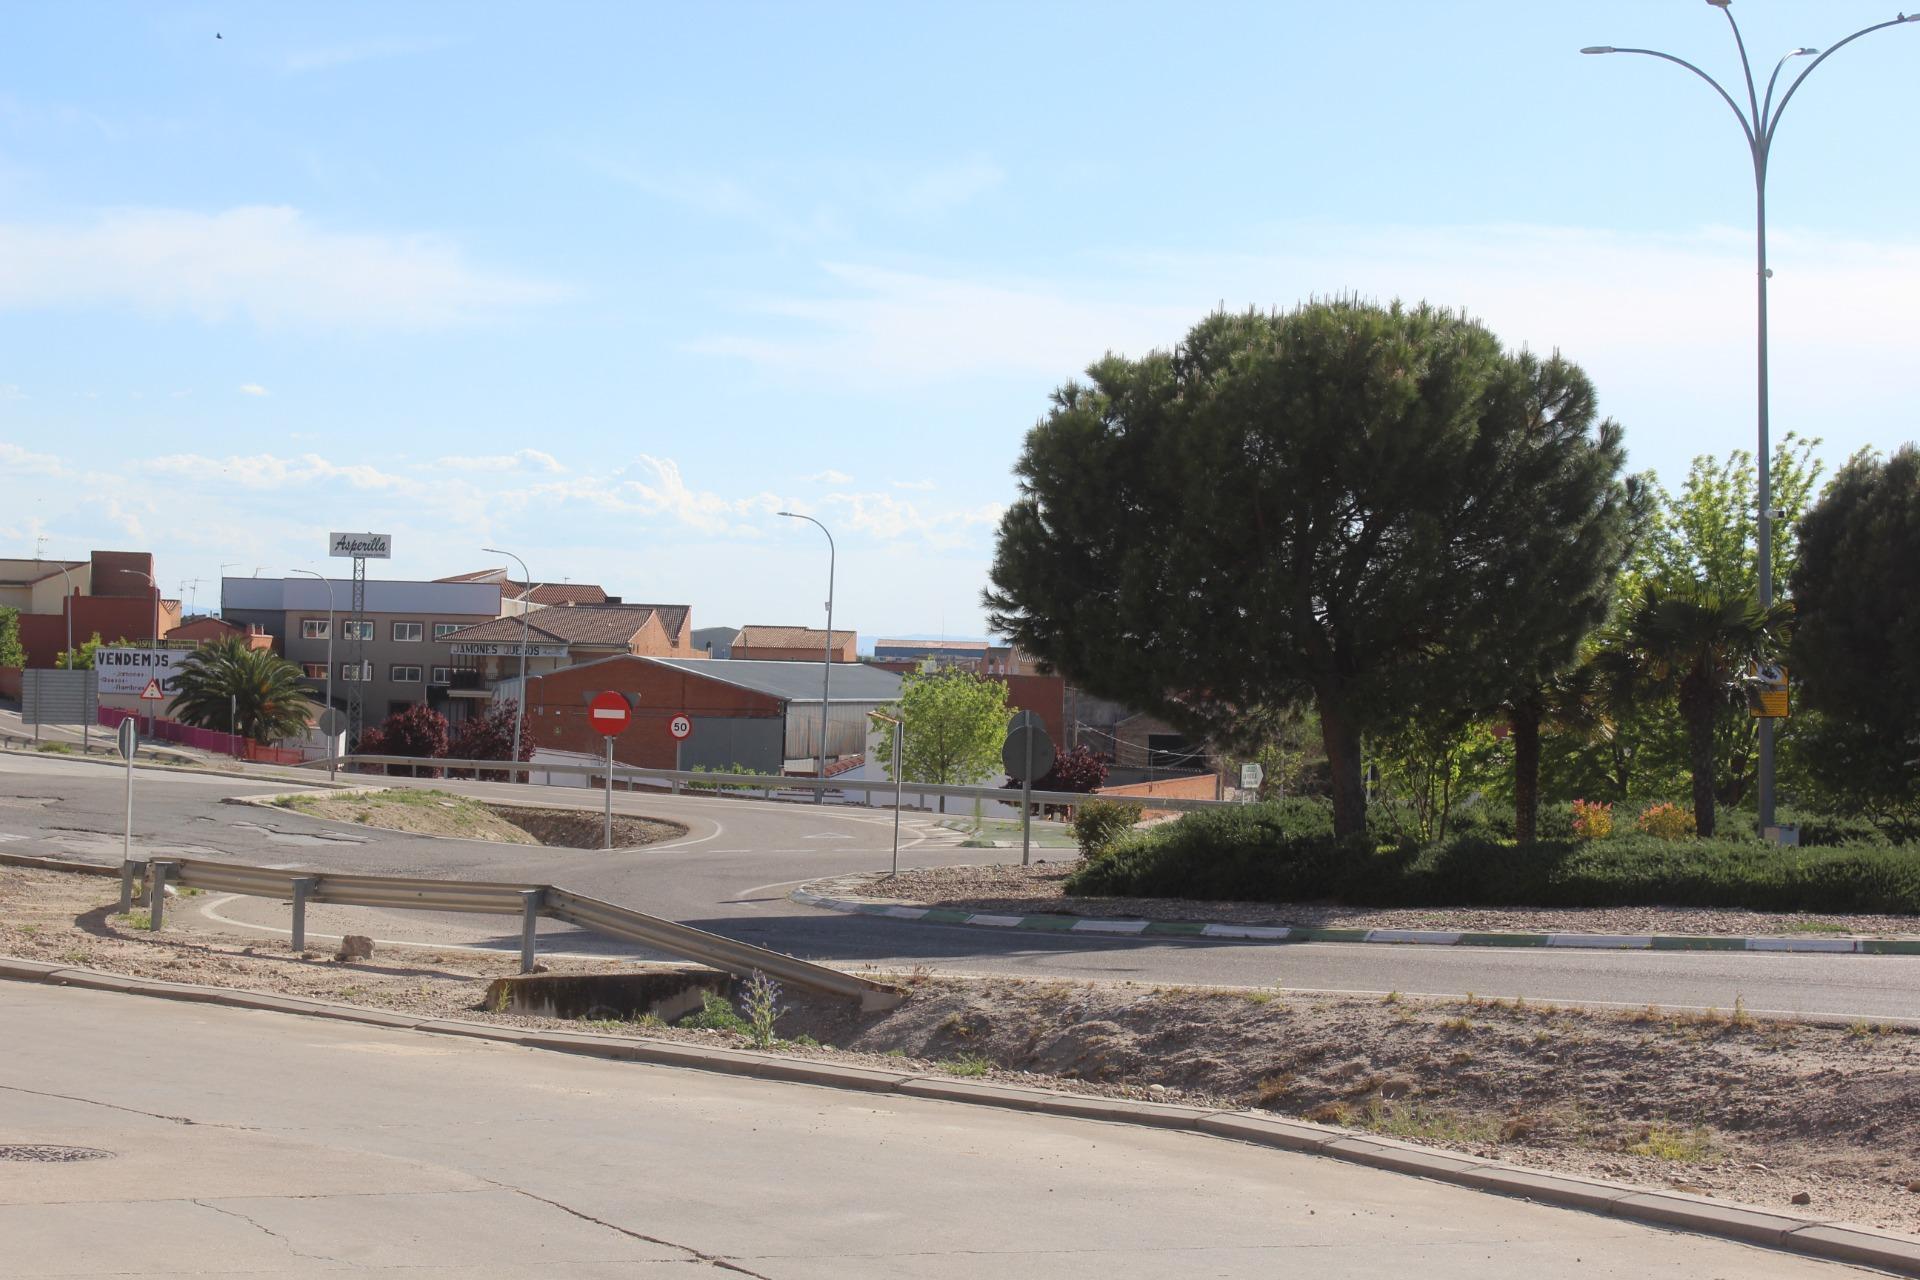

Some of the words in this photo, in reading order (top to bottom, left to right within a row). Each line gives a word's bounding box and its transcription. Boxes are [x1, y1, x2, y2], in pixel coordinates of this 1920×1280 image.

[335, 535, 386, 555] Asperilla
[453, 644, 498, 655] JAMONES
[674, 723, 687, 731] 50
